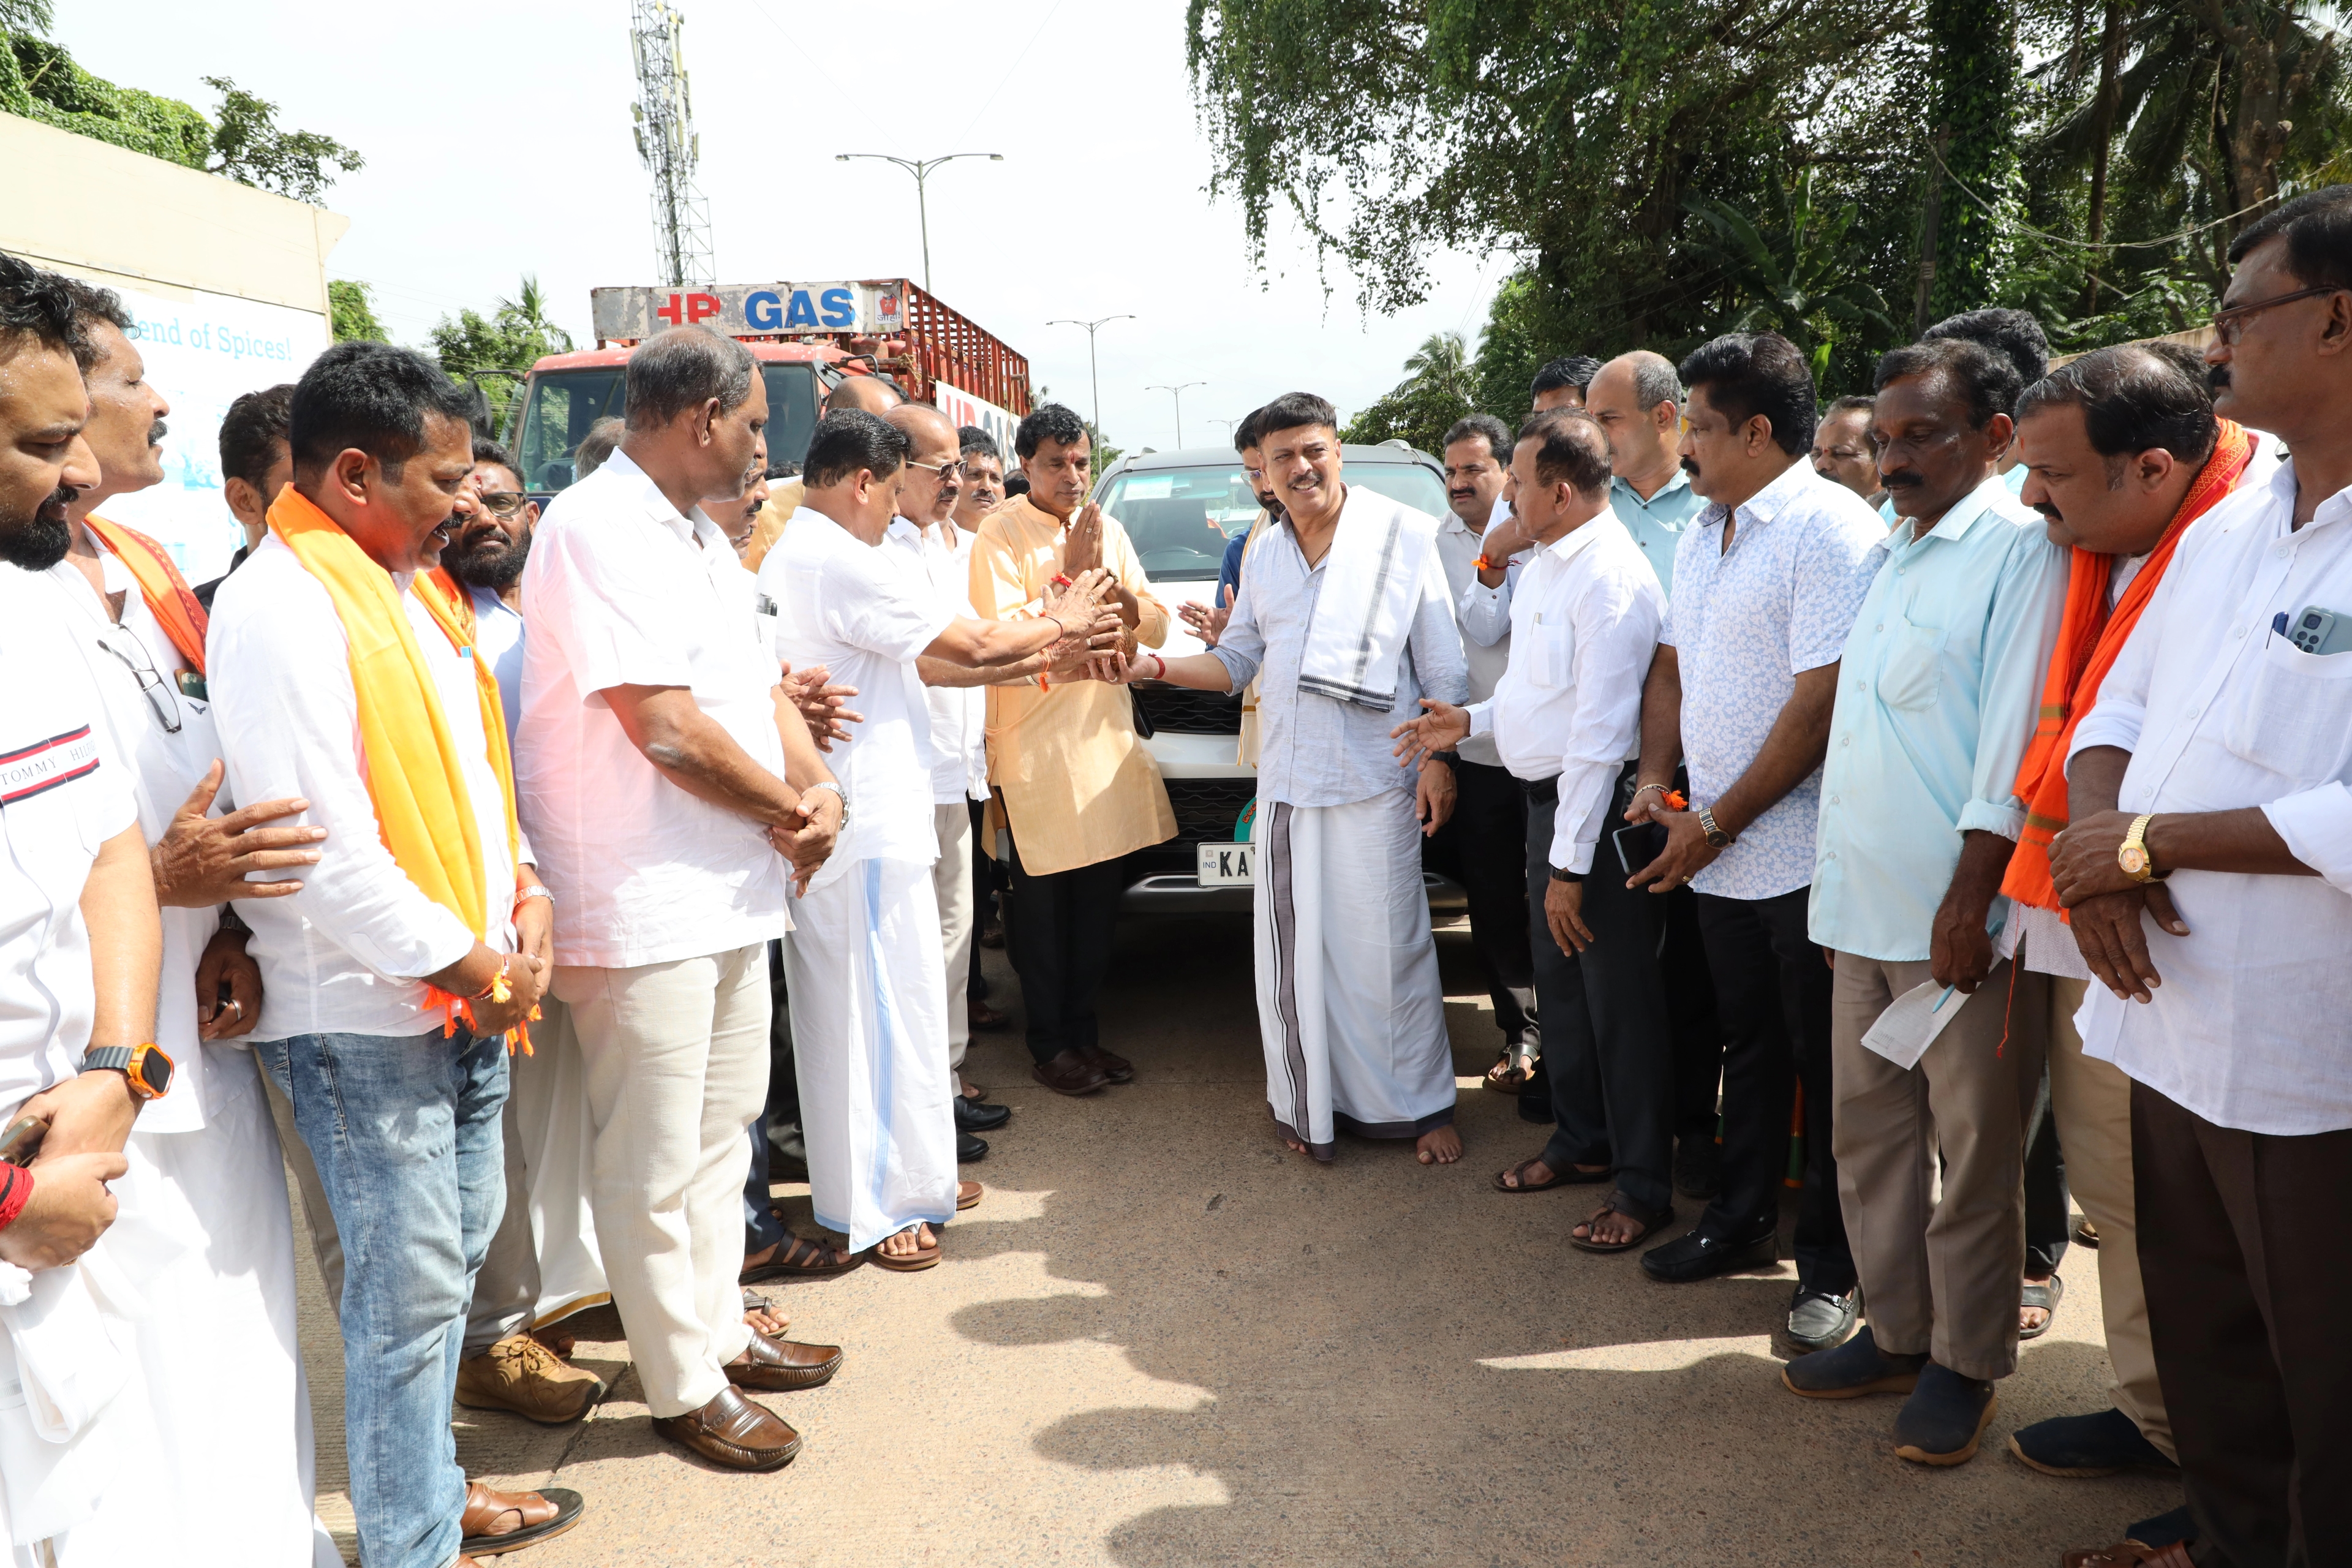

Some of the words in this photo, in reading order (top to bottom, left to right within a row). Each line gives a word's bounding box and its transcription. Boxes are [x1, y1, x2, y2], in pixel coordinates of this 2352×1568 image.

[745, 288, 856, 331] GAS
[124, 309, 183, 345] lend
[189, 323, 211, 350] of
[217, 326, 292, 361] Spices!
[0, 756, 56, 785] TOMMY
[69, 739, 96, 761] HILFIG
[1219, 851, 1255, 876] KA
